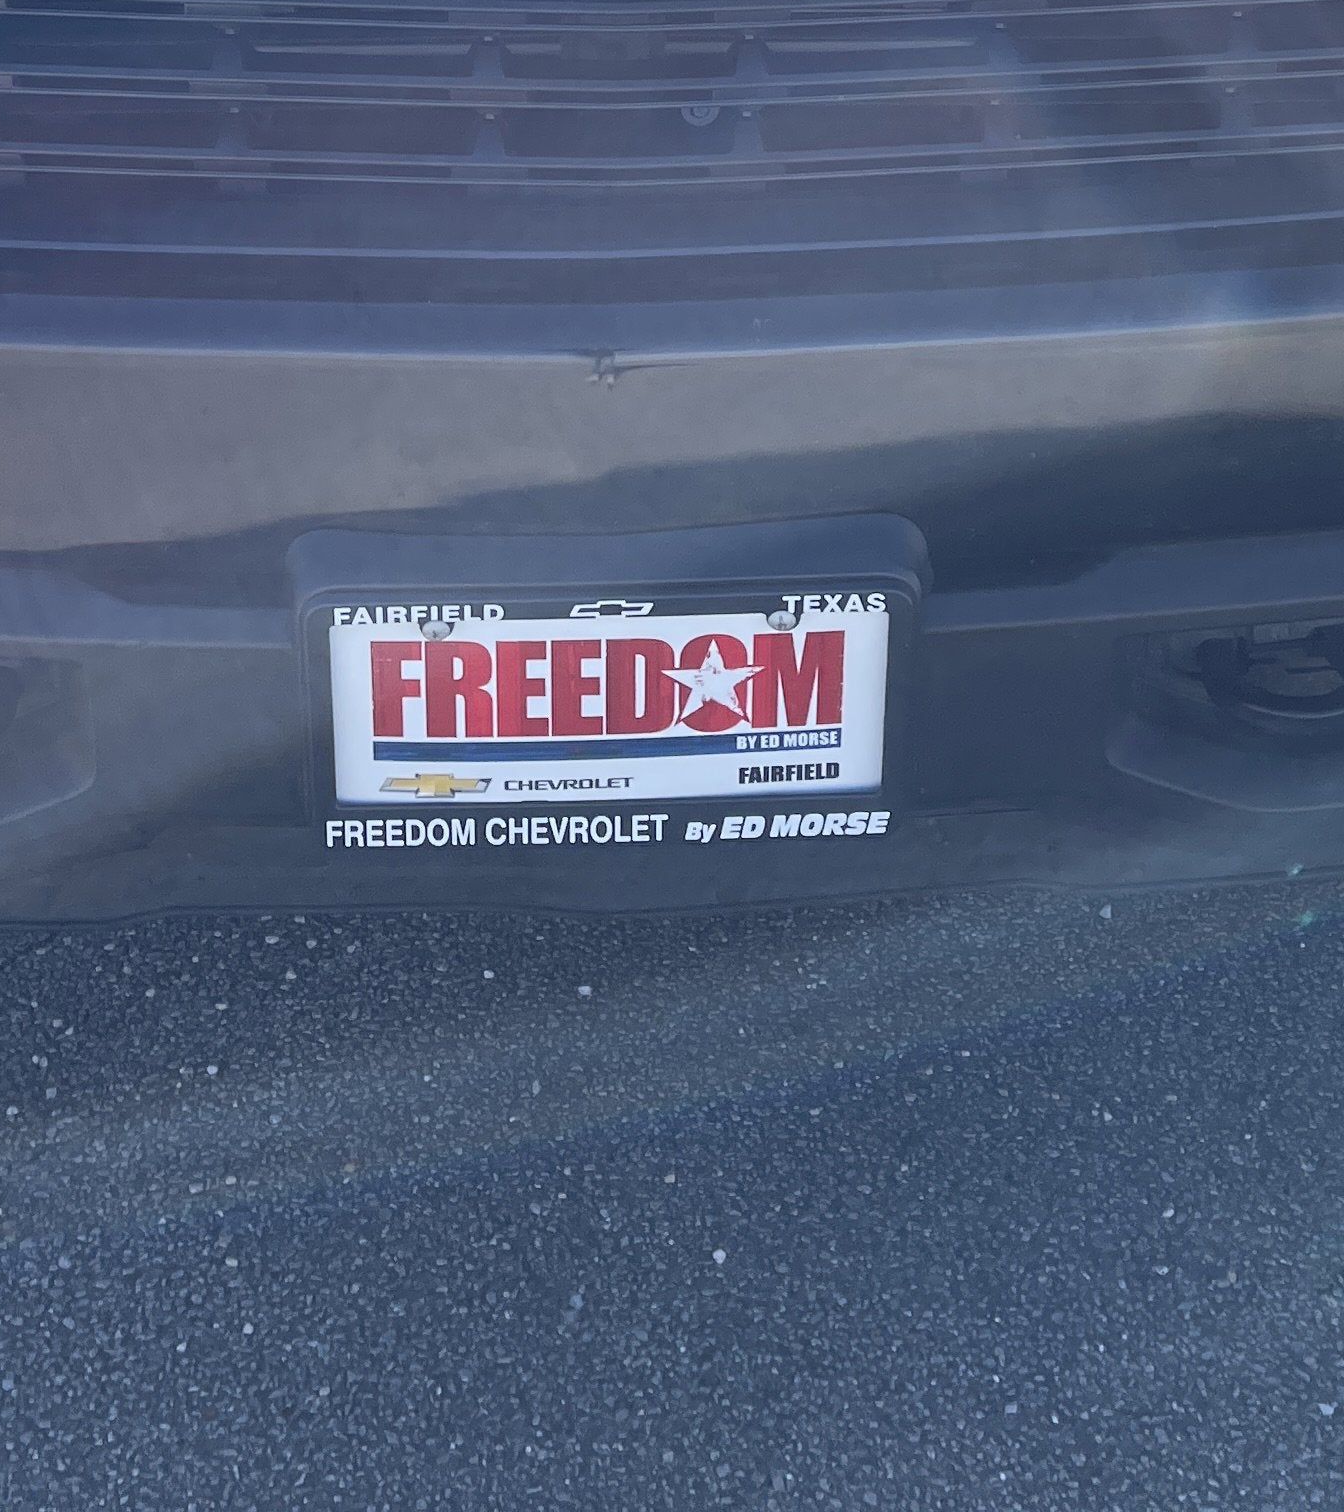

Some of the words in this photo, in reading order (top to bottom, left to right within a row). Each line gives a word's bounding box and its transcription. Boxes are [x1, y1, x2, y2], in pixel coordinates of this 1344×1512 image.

[333, 604, 505, 625] FAIRFIELD
[782, 592, 886, 614] TEXAS
[370, 631, 845, 738] FREEDOM
[736, 735, 757, 750] BY
[760, 733, 780, 748] ED
[783, 730, 838, 747] MORSE
[504, 776, 635, 791] CHEVROLET
[738, 762, 840, 784] FAIRFIELD
[325, 818, 476, 847] FREEDOM
[485, 814, 670, 846] CHEVROLET
[685, 821, 717, 844] By
[720, 815, 766, 840] ED
[769, 811, 891, 839] MORSE
